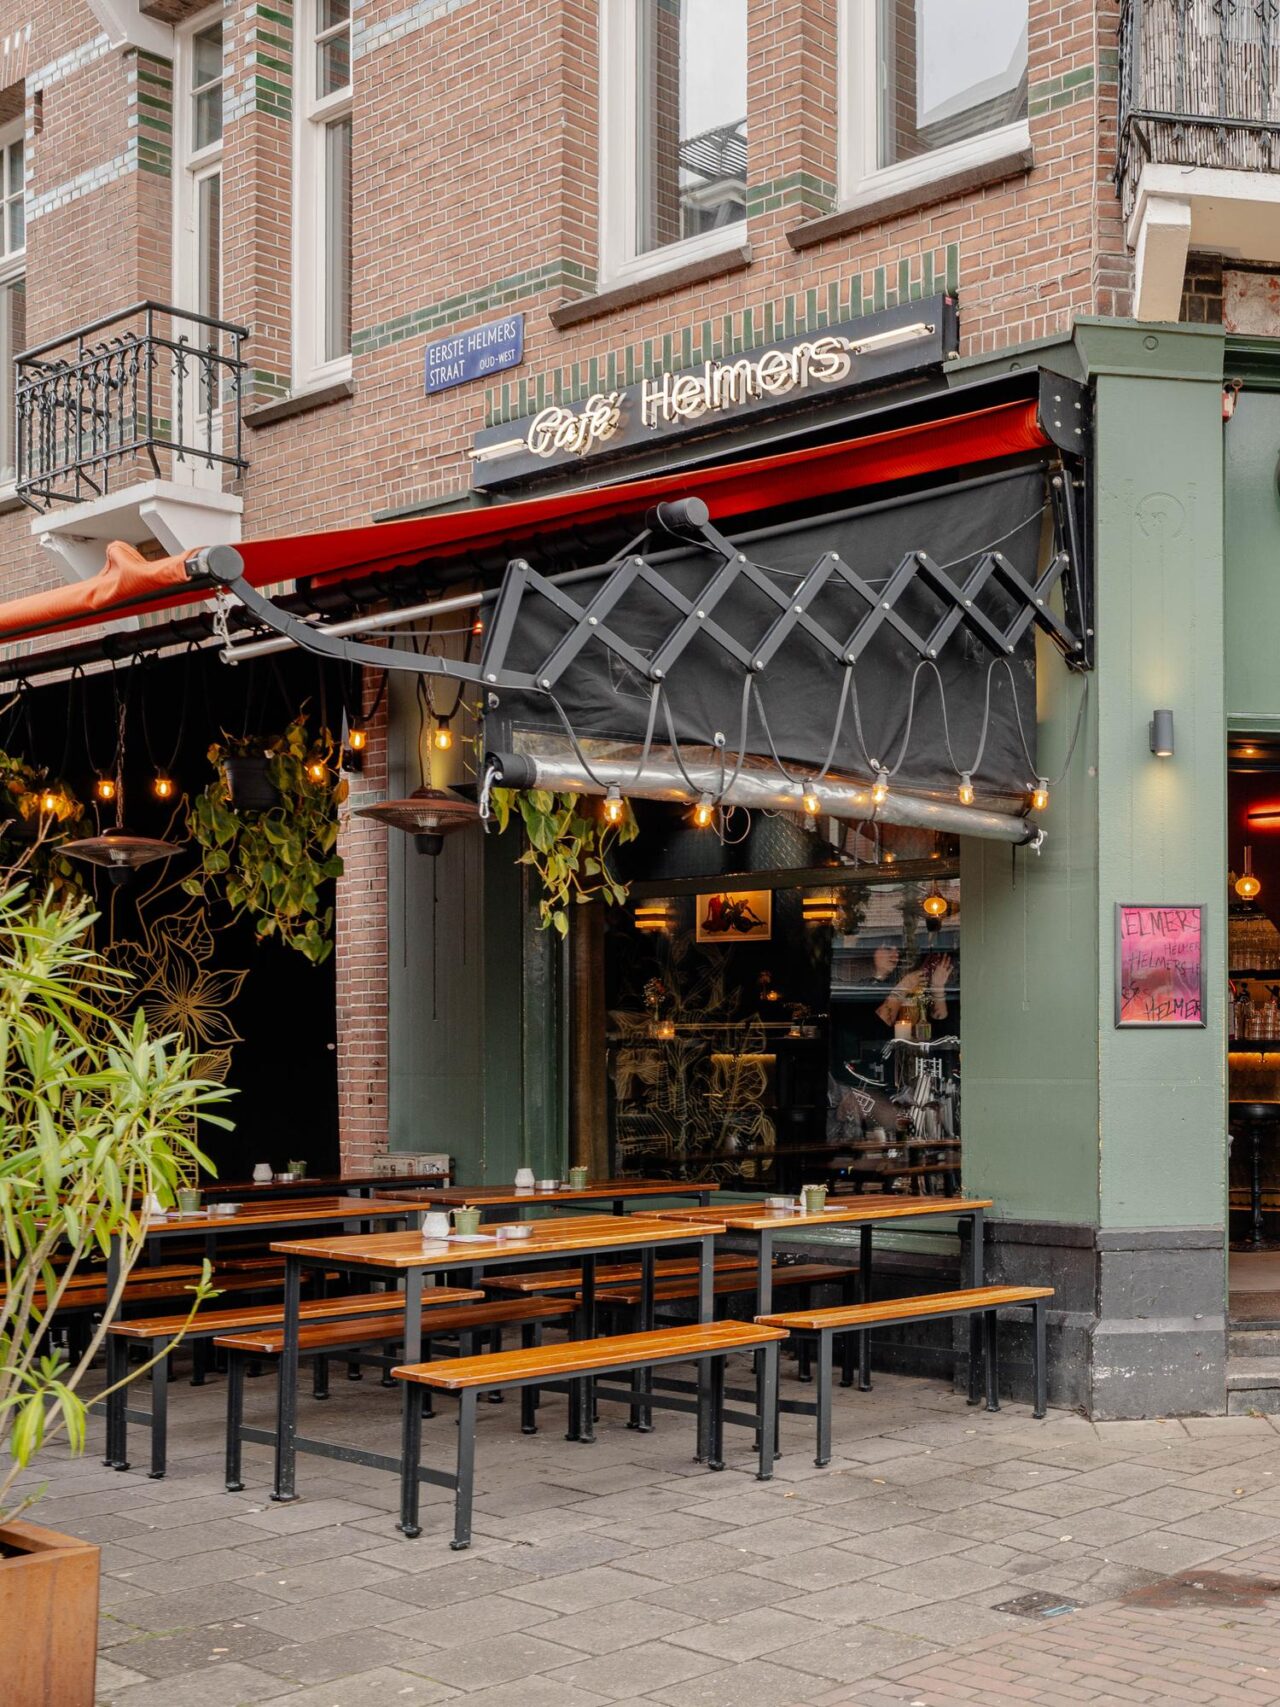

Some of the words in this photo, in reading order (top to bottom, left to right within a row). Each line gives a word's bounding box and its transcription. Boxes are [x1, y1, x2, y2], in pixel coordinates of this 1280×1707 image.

[430, 339, 464, 365] EERSTE
[468, 321, 516, 352] HELMERS
[480, 349, 516, 370] OUD-WEST
[430, 360, 465, 386] STRAAT
[527, 391, 626, 455] Café
[641, 337, 846, 429] Helmers
